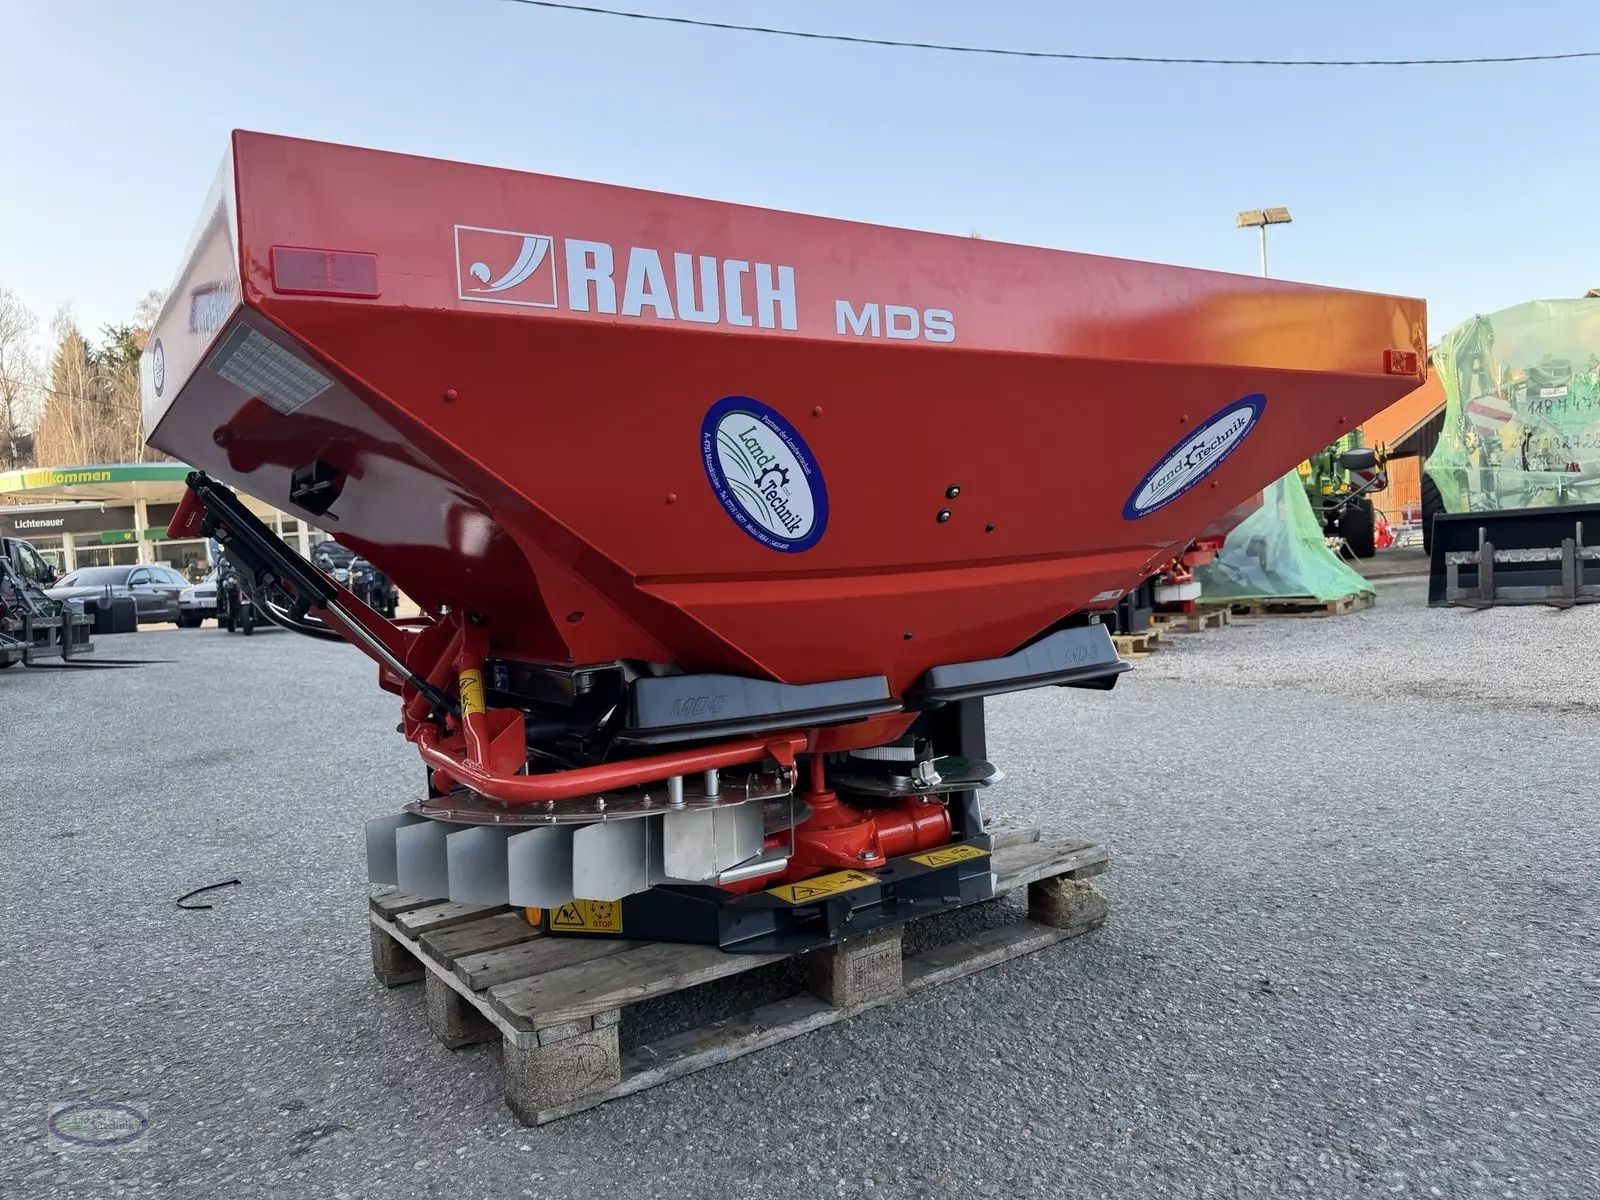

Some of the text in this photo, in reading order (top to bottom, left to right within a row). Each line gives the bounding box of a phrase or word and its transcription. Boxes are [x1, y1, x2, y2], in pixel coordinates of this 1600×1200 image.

[564, 238, 956, 343] RAUCH MDS
[738, 425, 776, 468] Land
[762, 415, 781, 432] Partner
[780, 431, 788, 440] der
[1195, 416, 1246, 460] Technik
[1150, 460, 1183, 493] Land
[14, 518, 65, 529] Lichtenauer
[761, 479, 802, 534] Technik
[593, 920, 613, 928] STOP
